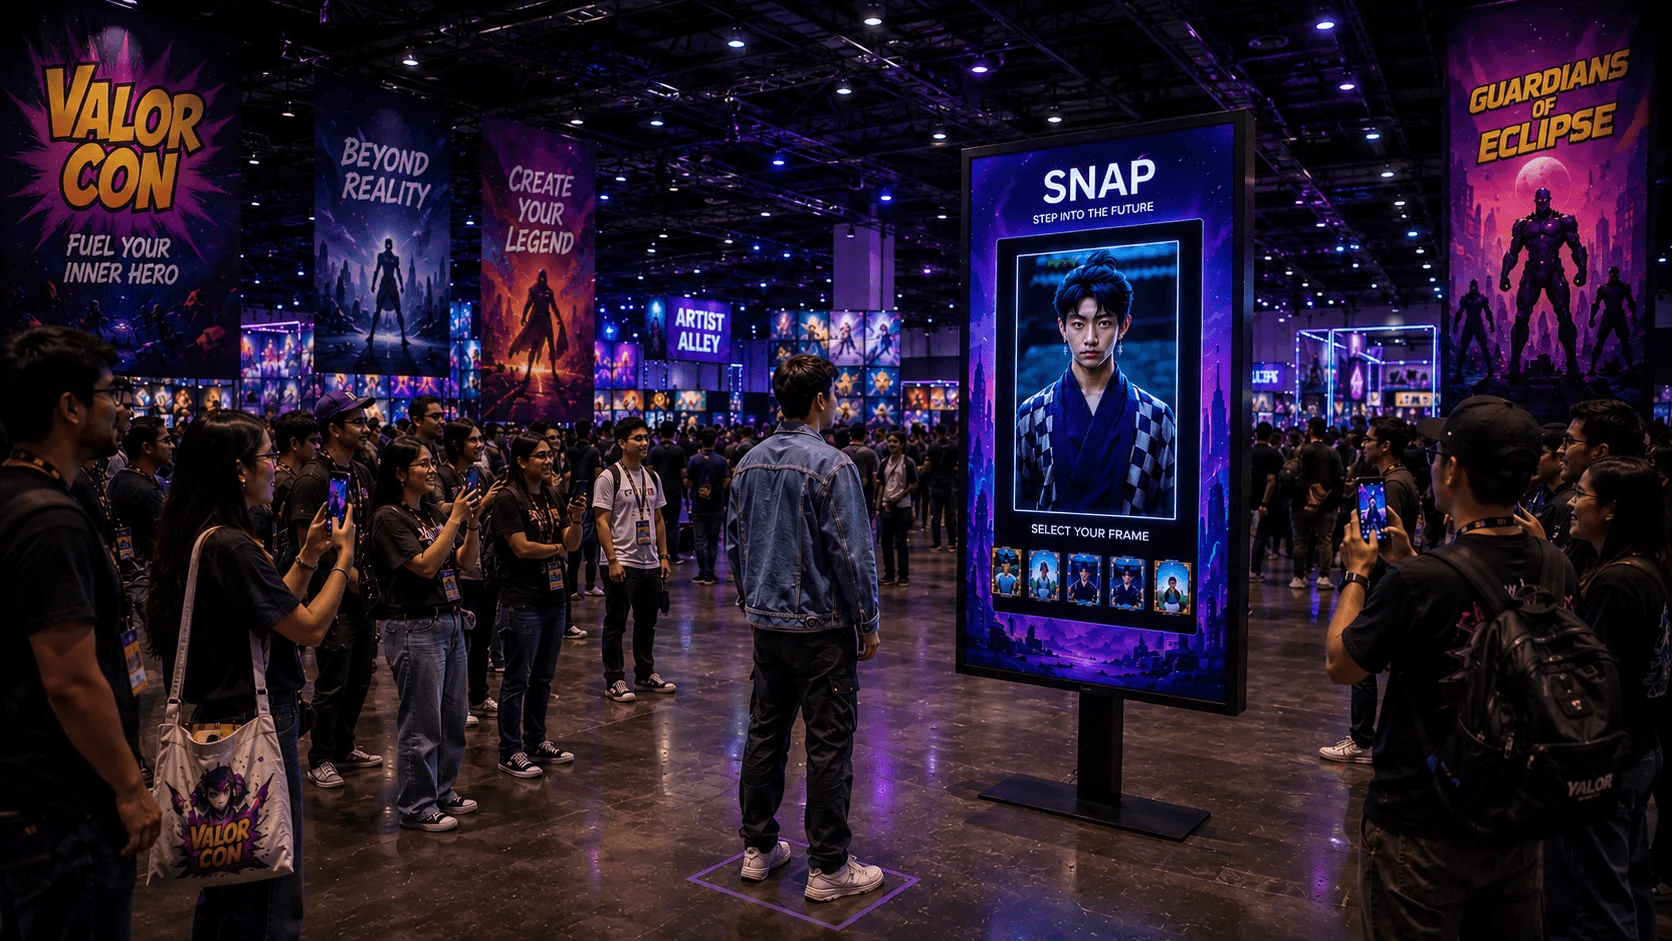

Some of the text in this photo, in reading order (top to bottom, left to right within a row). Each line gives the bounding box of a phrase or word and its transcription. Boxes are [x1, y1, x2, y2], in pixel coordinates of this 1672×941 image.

[1469, 49, 1630, 114] GUARDIANS
[44, 63, 206, 155] VALOR
[1532, 96, 1557, 118] OF
[1477, 102, 1617, 164] ECLIPSE
[340, 136, 430, 177] BEYOND
[61, 142, 181, 211] CON
[341, 171, 432, 211] REALITY
[508, 164, 575, 197] CREATE
[1043, 158, 1156, 204] SNAP
[518, 197, 565, 226] YOUR
[1032, 201, 1155, 225] STEP INTO THE FUTURE
[66, 233, 171, 259] FUEL YOUR
[504, 225, 575, 255] LEGEND
[63, 262, 179, 285] INNER HERO
[675, 307, 726, 332] ARTIST
[677, 331, 721, 354] ALLEY
[1031, 523, 1150, 542] SELECT YOUR FRAME
[190, 817, 251, 850] VALOR
[198, 842, 244, 868] CON
